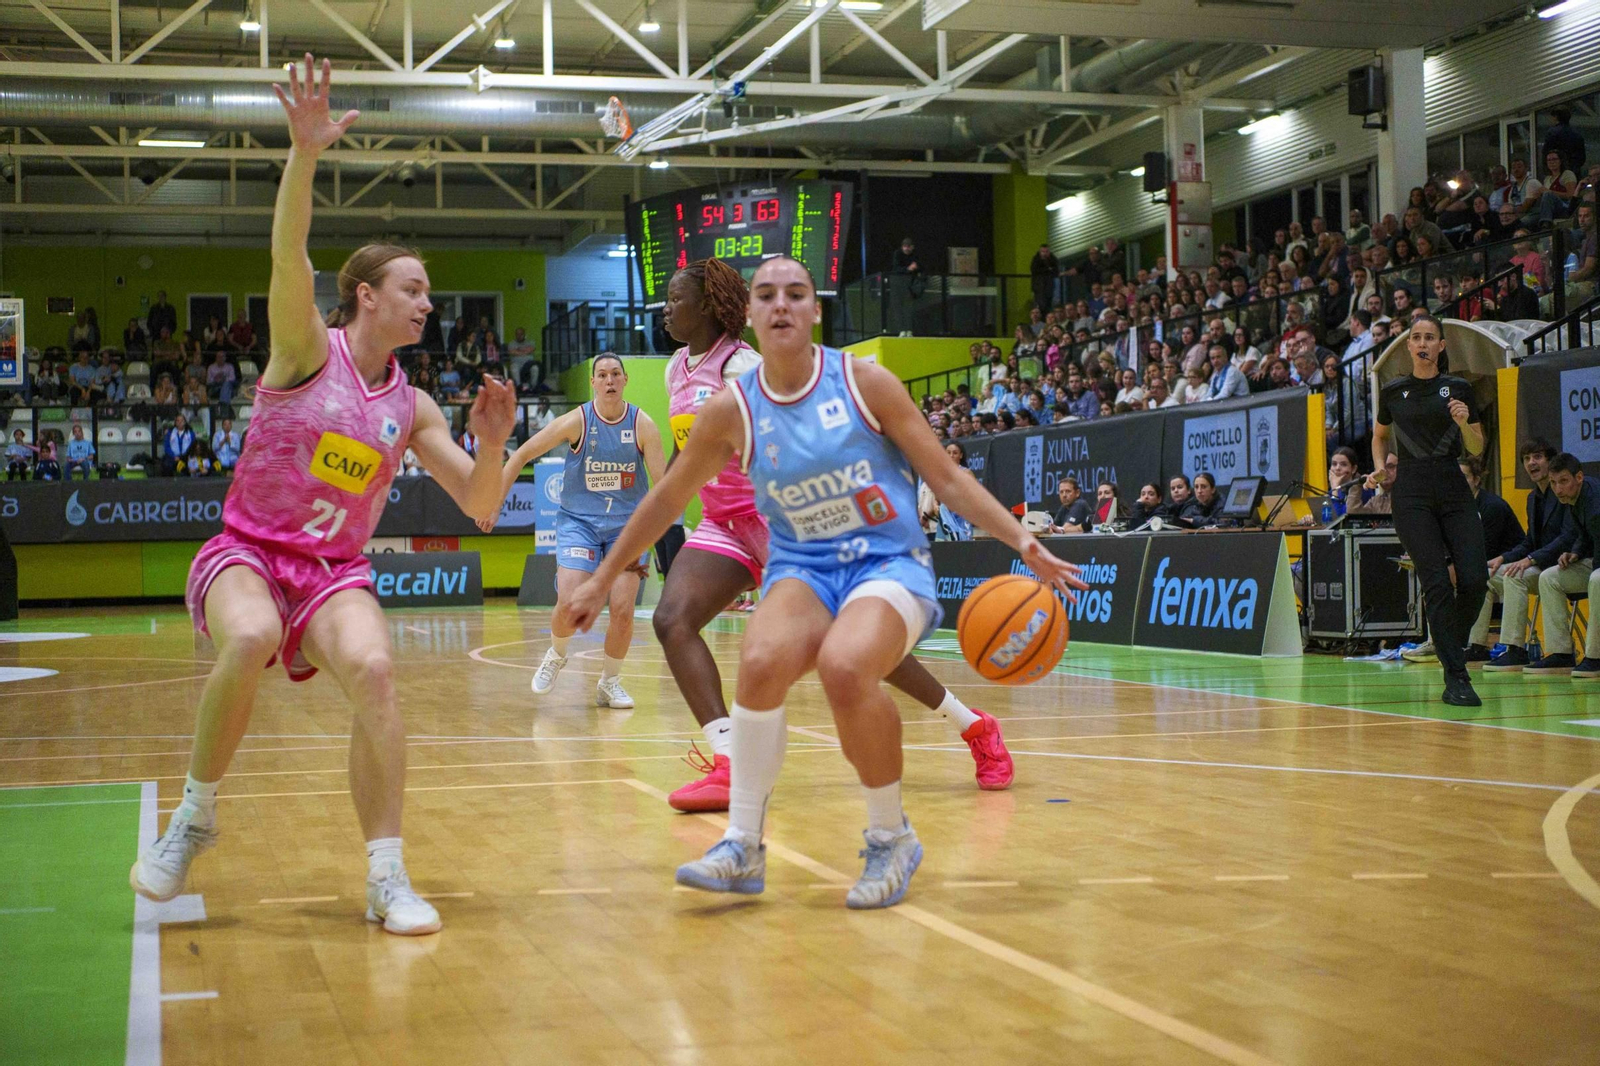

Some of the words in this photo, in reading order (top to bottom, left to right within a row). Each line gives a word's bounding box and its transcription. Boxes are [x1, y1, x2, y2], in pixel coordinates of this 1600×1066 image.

[702, 206, 724, 227] 54
[733, 204, 743, 222] 3
[757, 199, 779, 222] 63
[715, 235, 763, 259] 03:23
[676, 428, 690, 440] CA
[1188, 427, 1242, 450] CONCELLO
[1047, 436, 1090, 464] XUNTA
[1194, 454, 1208, 471] DE
[1211, 451, 1236, 469] VIGO
[323, 451, 373, 481] CADÍ
[585, 456, 636, 472] femxa
[767, 459, 874, 509] femxa
[1046, 470, 1062, 496] DE
[94, 496, 222, 524] CABREIRO
[605, 497, 613, 513] 7
[792, 504, 851, 526] CONCELLO
[303, 498, 348, 542] 21
[802, 525, 818, 535] DE
[819, 513, 850, 531] VIGO
[371, 566, 468, 597] ecalvi
[936, 577, 963, 599] CELTA
[1149, 557, 1259, 630] femxa
